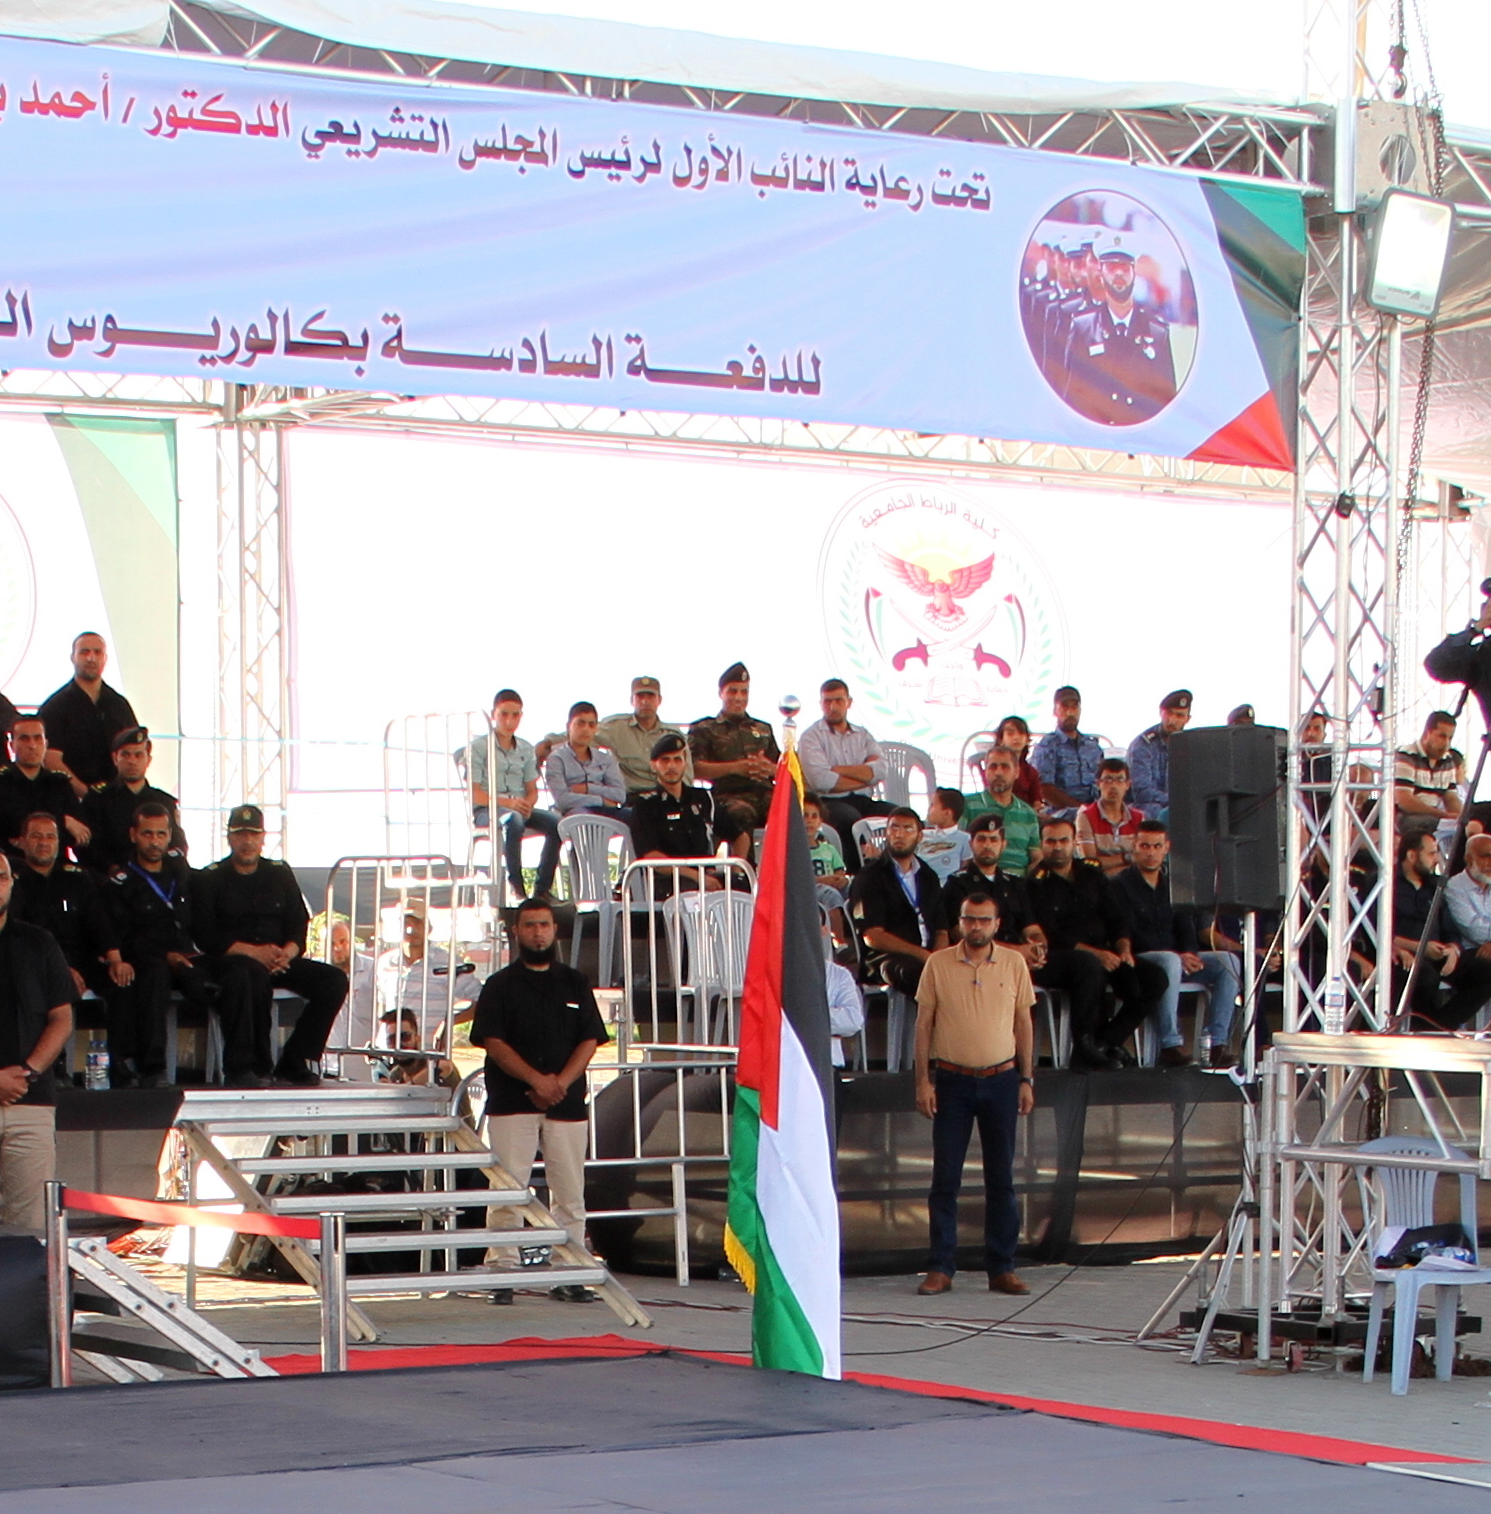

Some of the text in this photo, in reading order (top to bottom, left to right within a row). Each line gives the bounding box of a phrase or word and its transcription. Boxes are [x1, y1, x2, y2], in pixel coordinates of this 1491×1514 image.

[19, 73, 109, 119] أحمد
[145, 89, 290, 139] الدكتور
[301, 106, 450, 159] التشريعي
[458, 124, 558, 174] المجلس
[567, 140, 662, 184] لرئيس
[672, 133, 742, 190] الأول
[750, 151, 835, 198] النائب
[843, 158, 924, 212] رعاية
[931, 169, 991, 211] تحت
[47, 307, 370, 377] بكالوريوس
[380, 313, 614, 379] السادسة
[624, 333, 821, 396] للدفعة
